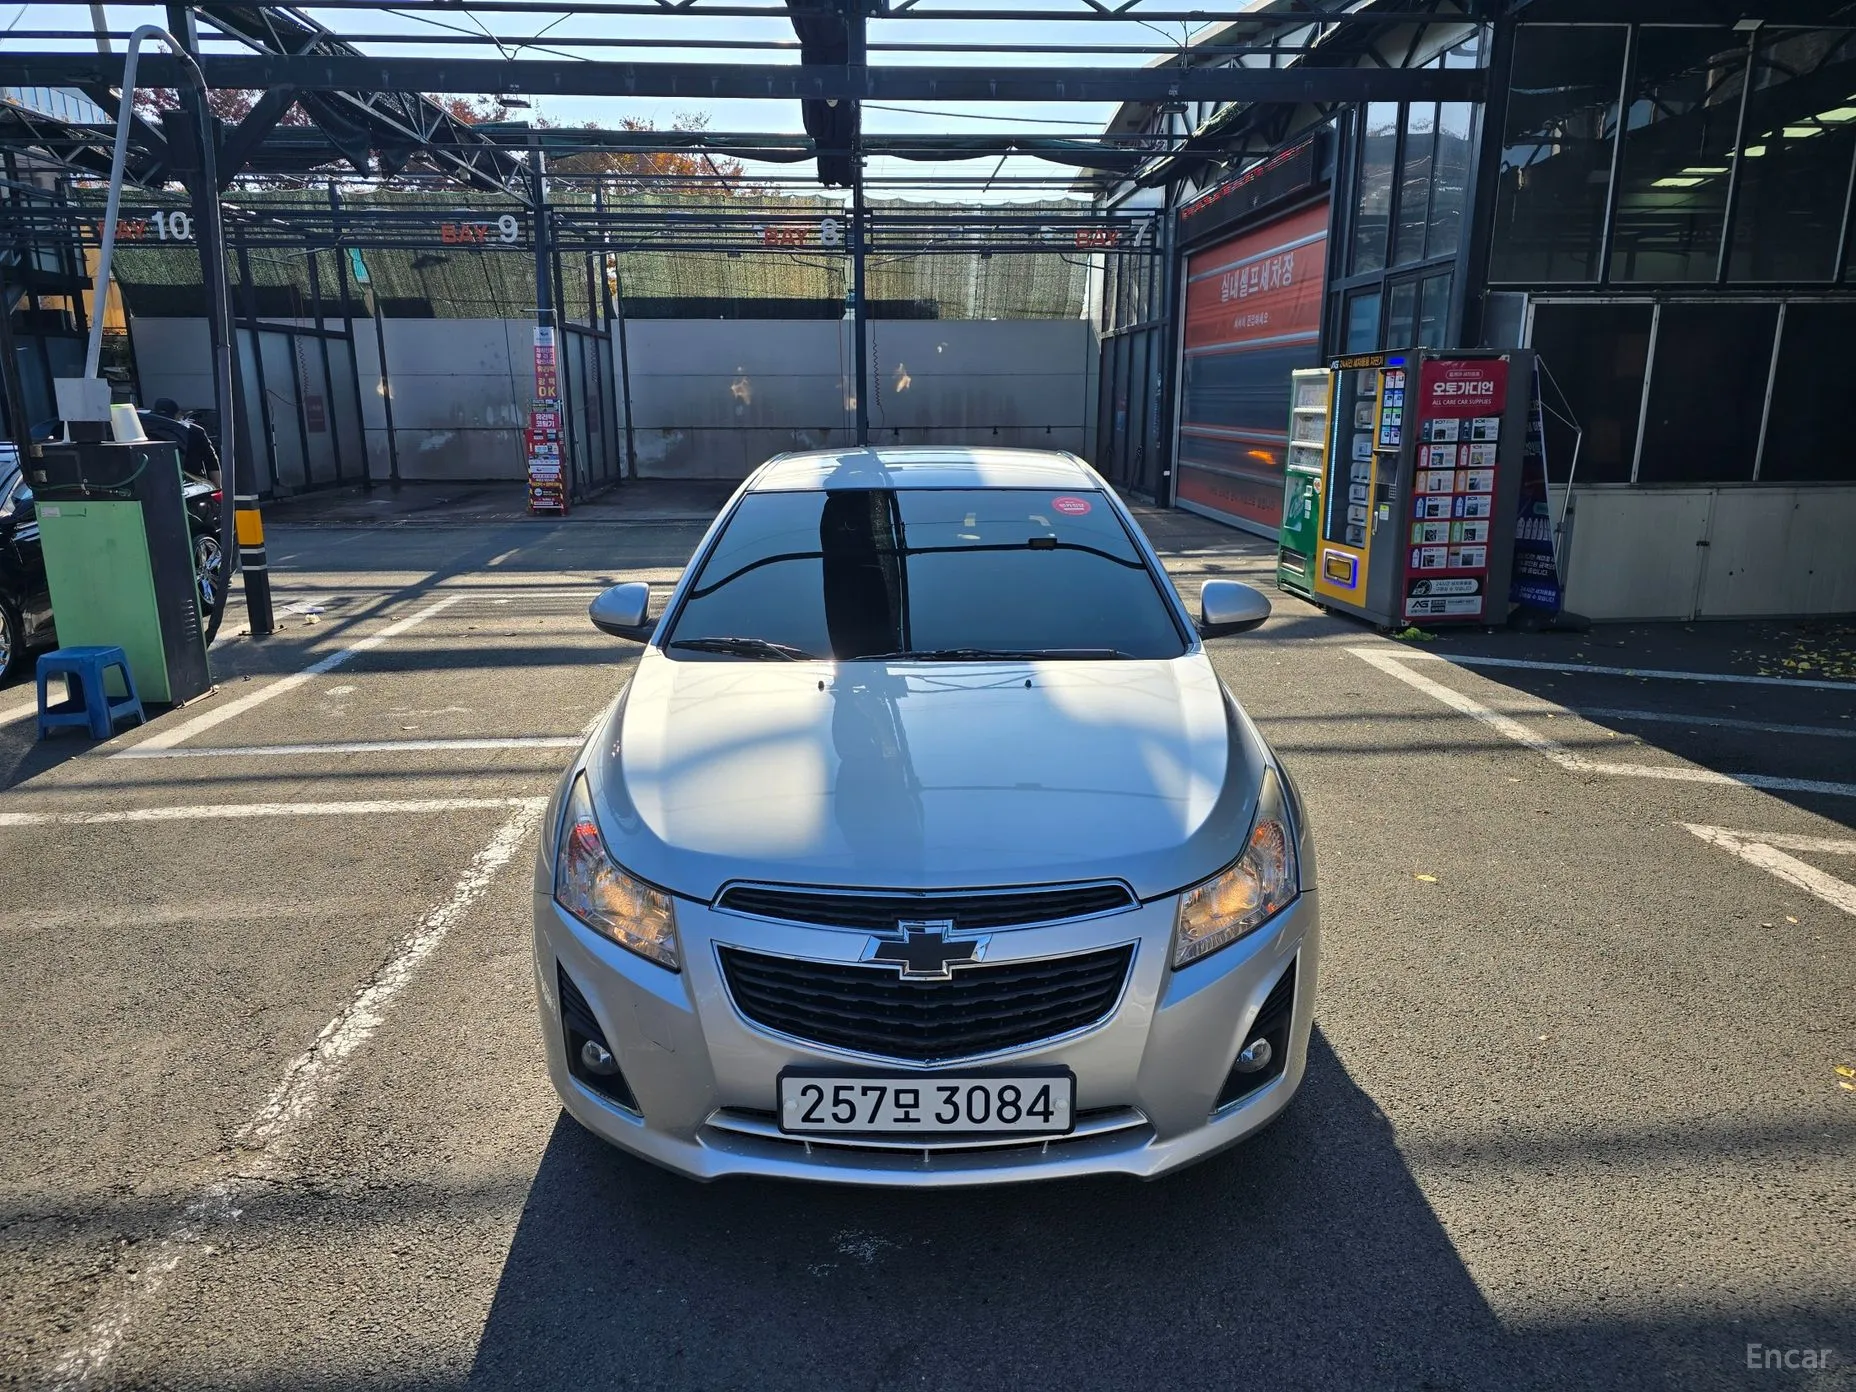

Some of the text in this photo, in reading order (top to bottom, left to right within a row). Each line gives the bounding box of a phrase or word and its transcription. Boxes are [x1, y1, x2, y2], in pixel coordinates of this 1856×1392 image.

[152, 211, 190, 240] 10
[441, 214, 518, 243] BAY 9
[764, 218, 839, 246] BAY 8
[1075, 219, 1150, 247] BAY 7
[538, 386, 556, 397] OK
[1432, 381, 1494, 396] 오토가디언
[1411, 600, 1430, 608] AG
[801, 1084, 1055, 1124] 257모 3084
